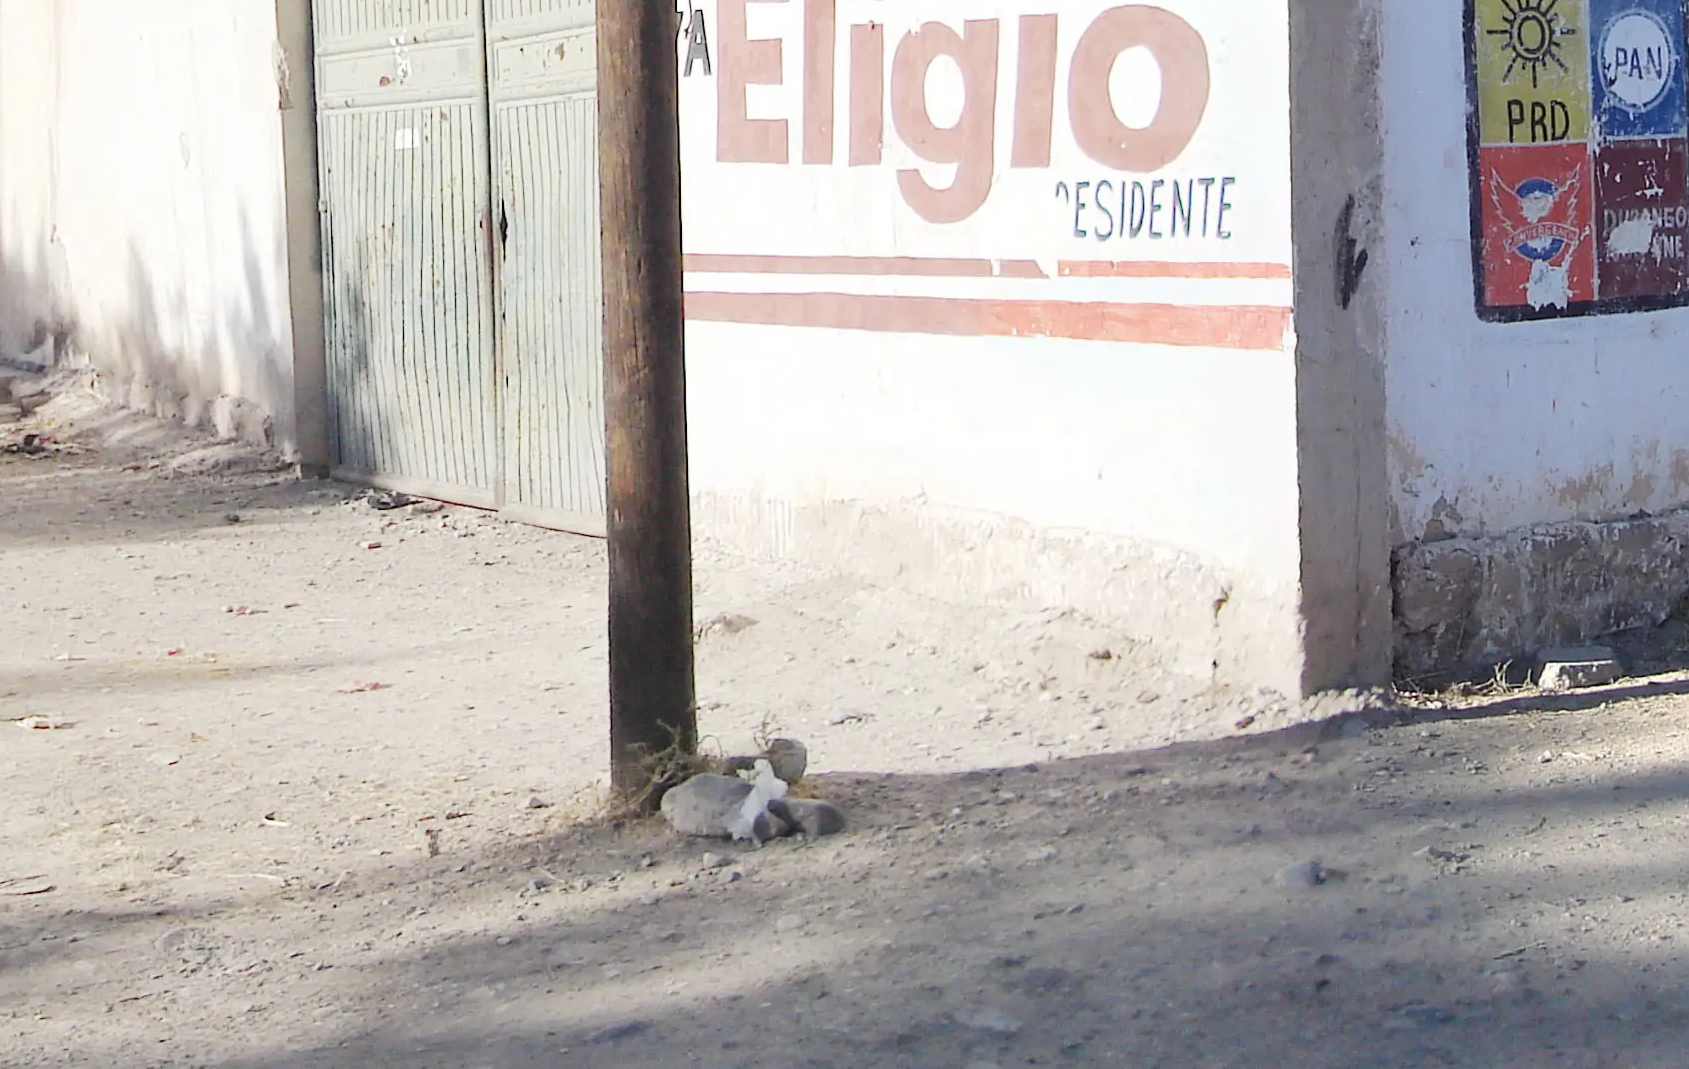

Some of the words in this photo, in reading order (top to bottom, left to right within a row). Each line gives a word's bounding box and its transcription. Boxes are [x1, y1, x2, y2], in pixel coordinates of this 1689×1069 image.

[1615, 46, 1663, 79] PAN
[1507, 98, 1570, 143] PRD
[1055, 176, 1236, 240] ESIDENTE
